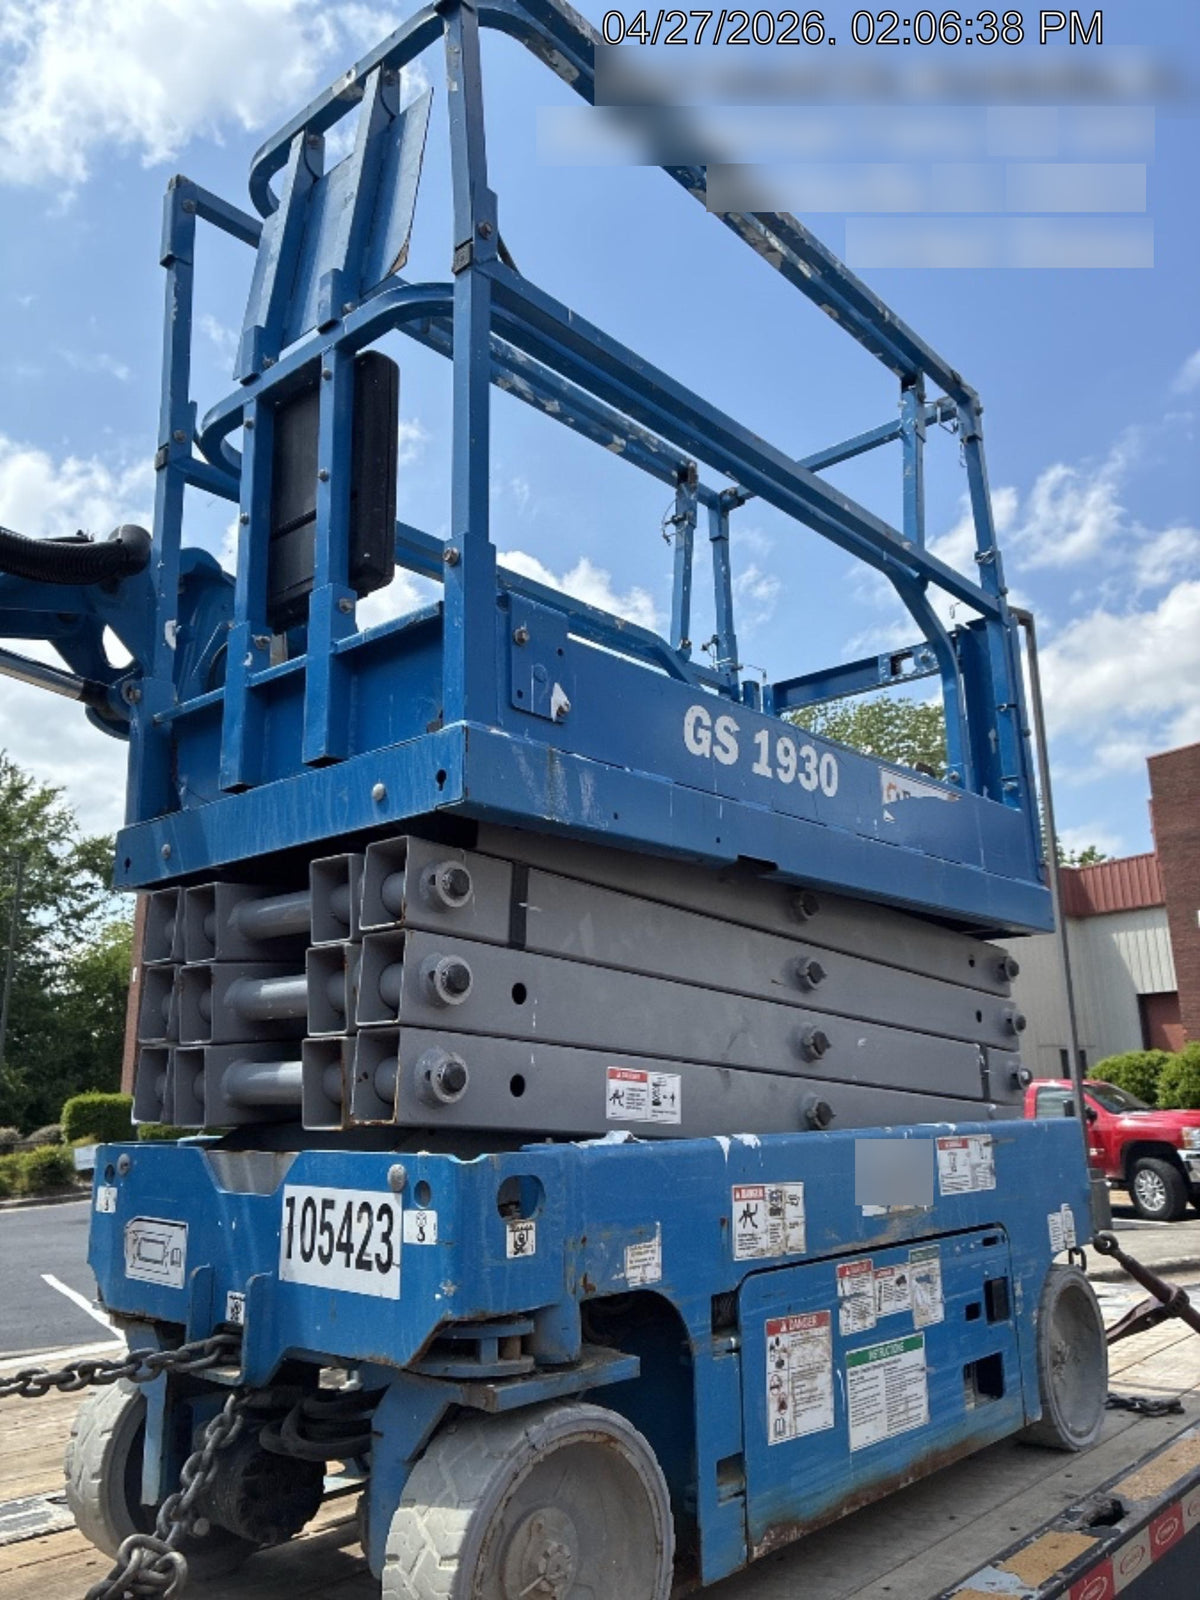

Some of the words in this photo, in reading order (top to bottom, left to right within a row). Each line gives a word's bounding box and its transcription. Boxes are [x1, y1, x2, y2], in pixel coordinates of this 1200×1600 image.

[683, 704, 740, 766] GS
[752, 729, 839, 798] 1930
[284, 1195, 394, 1274] 105423
